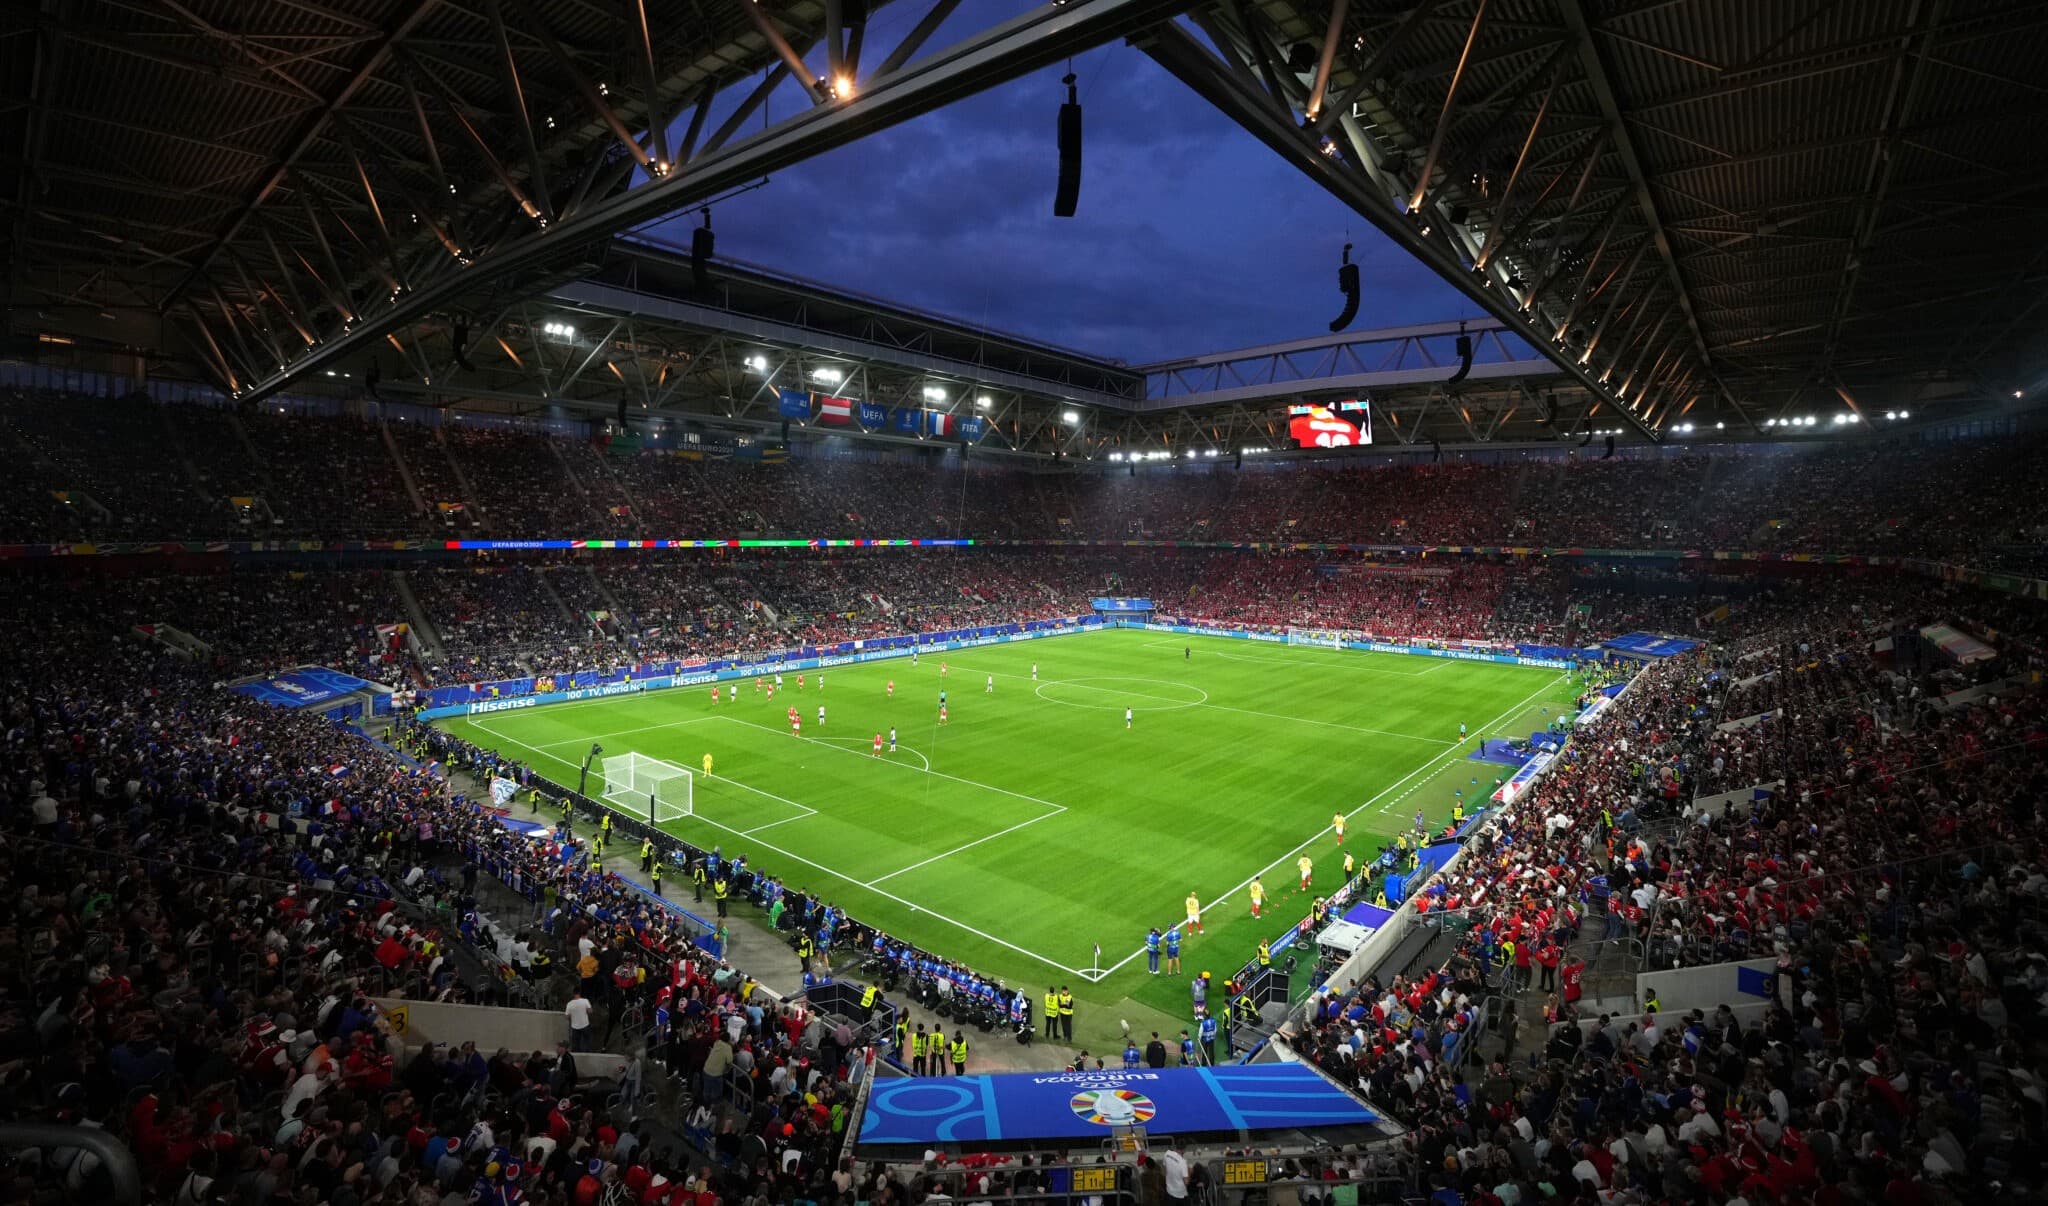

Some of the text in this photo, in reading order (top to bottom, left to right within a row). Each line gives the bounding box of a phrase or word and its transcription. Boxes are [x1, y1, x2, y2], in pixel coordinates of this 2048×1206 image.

[863, 408, 884, 422] UEFA
[962, 424, 978, 433] FIFA
[1248, 632, 1281, 642] Hisense
[1370, 643, 1409, 654] Hisense
[1458, 651, 1479, 659] World
[1480, 653, 1495, 661] No.1
[682, 657, 706, 667] URBACH
[787, 663, 800, 671] No.1
[818, 656, 854, 668] Hisense
[1518, 657, 1566, 669] Hisense
[671, 673, 718, 687] Hisense
[603, 683, 629, 695] World
[471, 698, 536, 714] Hisense
[1033, 1073, 1160, 1084] EURO2024
[1240, 1170, 1248, 1181] 11
[1090, 1177, 1098, 1188] 11
